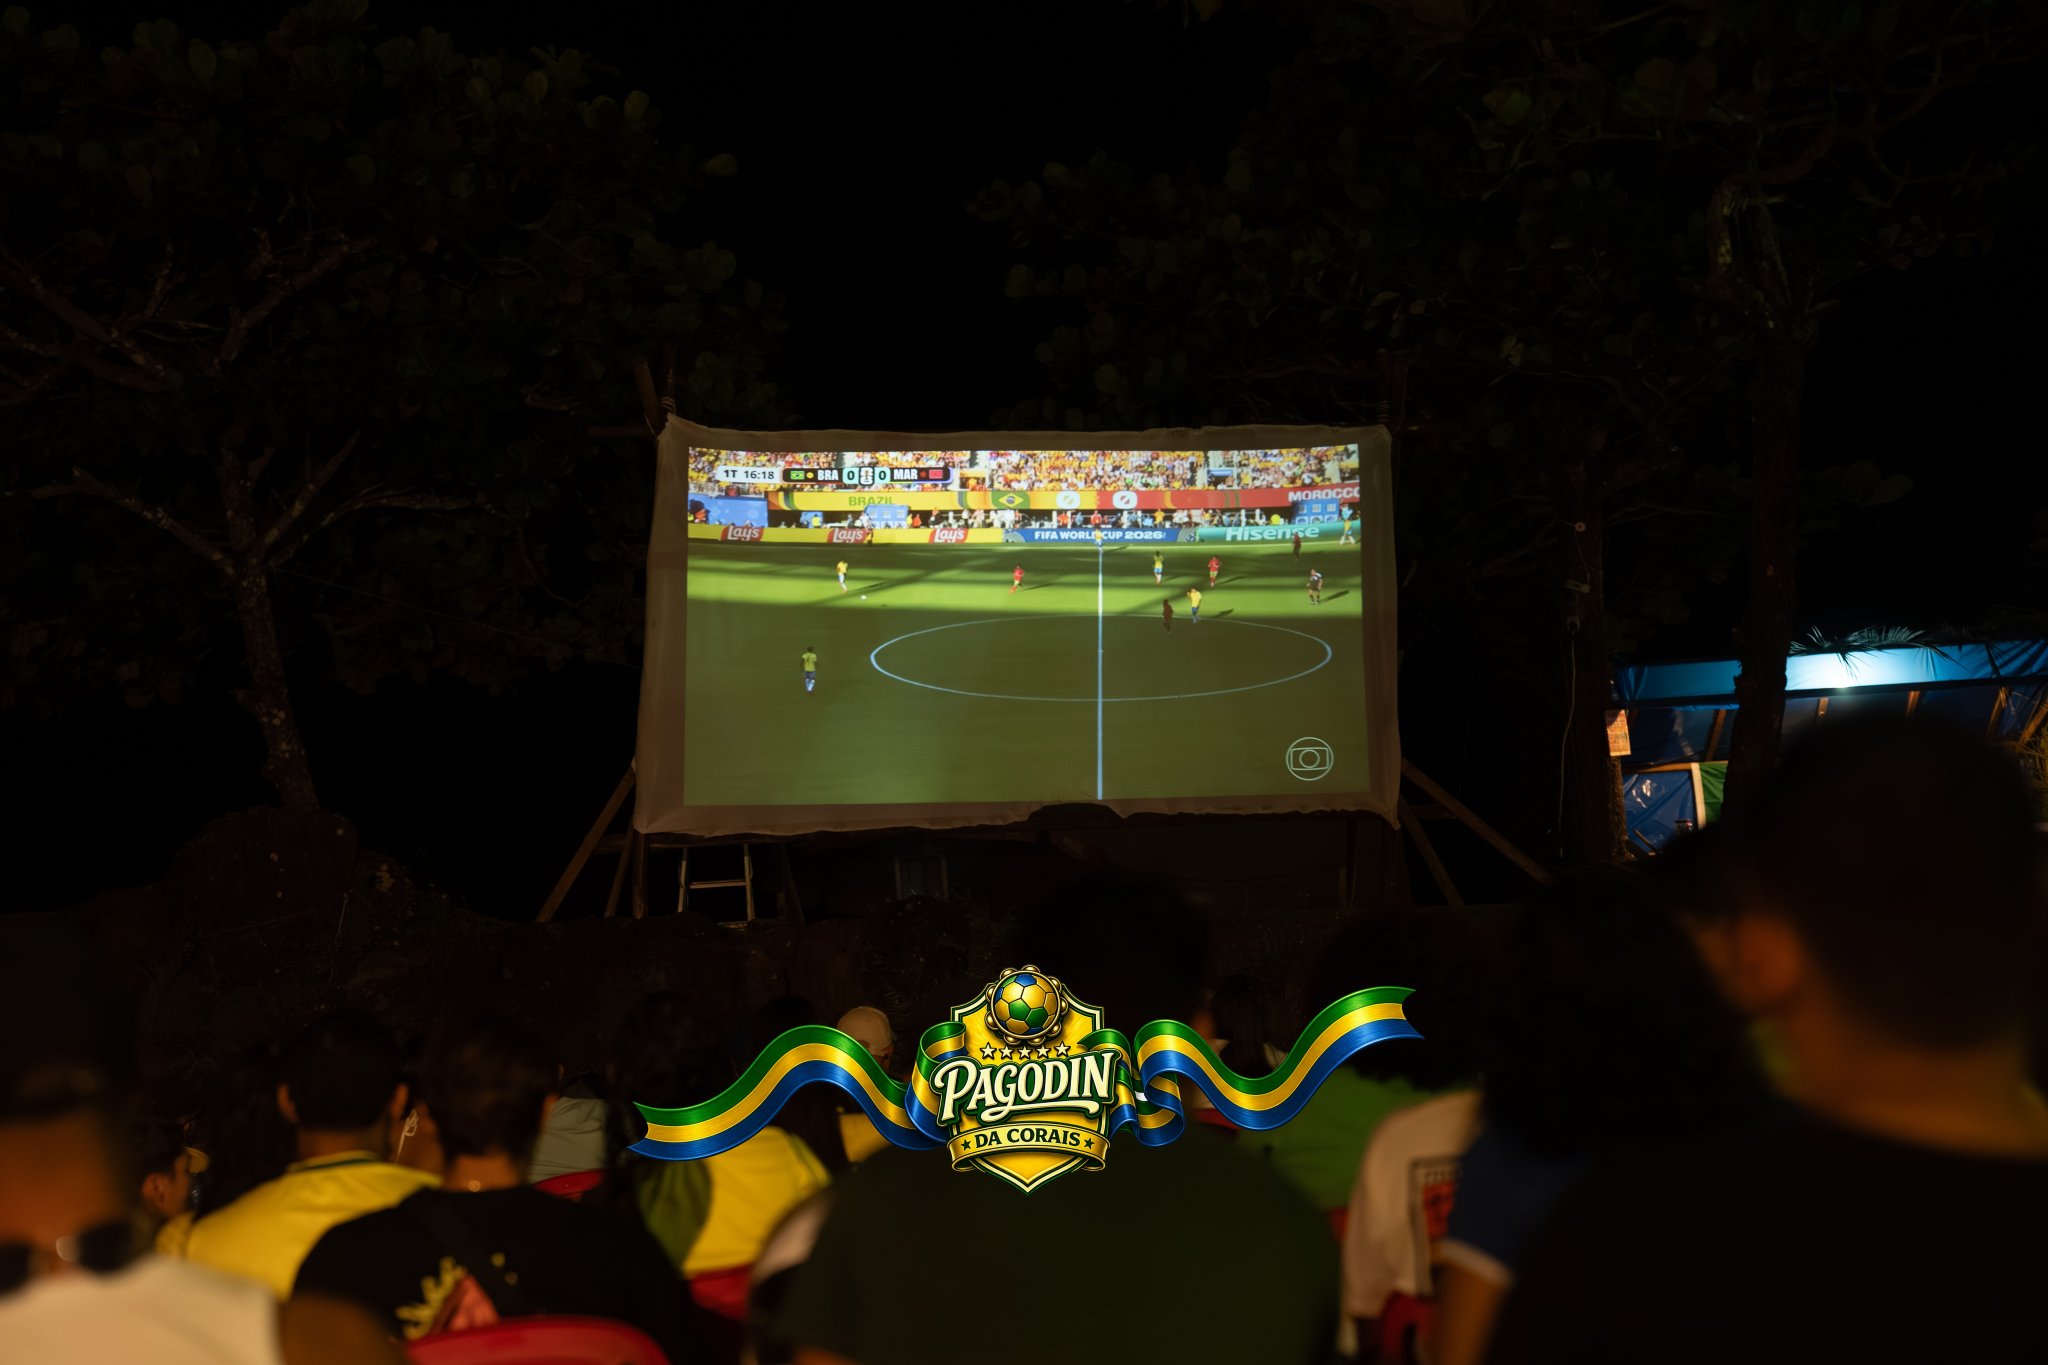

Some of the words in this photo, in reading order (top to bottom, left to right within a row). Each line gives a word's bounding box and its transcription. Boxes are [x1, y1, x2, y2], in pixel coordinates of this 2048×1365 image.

[723, 469, 738, 478] 1T
[744, 470, 774, 480] 16:18
[817, 469, 839, 481] BRA
[847, 470, 855, 481] 0
[878, 470, 887, 481] 0
[893, 468, 918, 481] MAR
[1034, 530, 1058, 540] FIFA
[1103, 530, 1122, 540] CUP
[1124, 530, 1161, 540] 2026
[1225, 526, 1320, 541] Hisense
